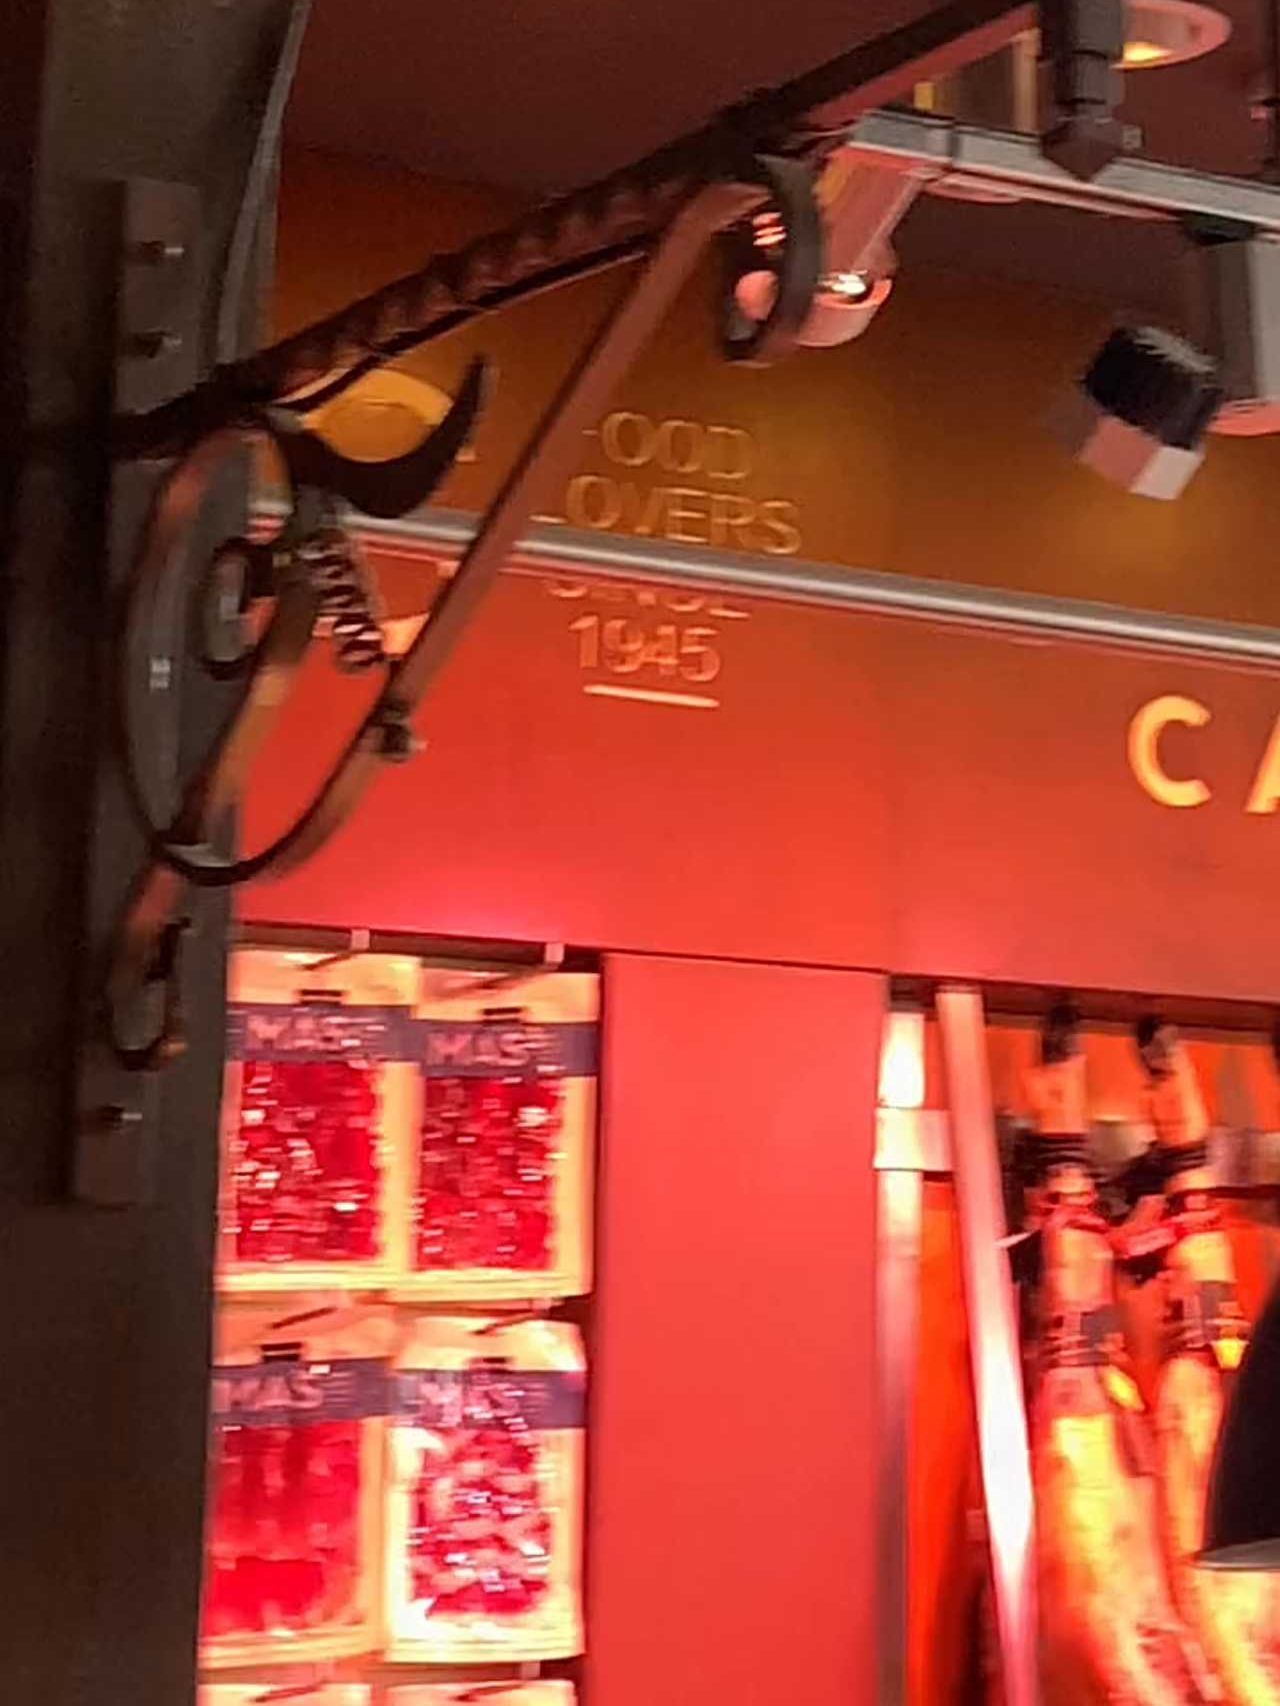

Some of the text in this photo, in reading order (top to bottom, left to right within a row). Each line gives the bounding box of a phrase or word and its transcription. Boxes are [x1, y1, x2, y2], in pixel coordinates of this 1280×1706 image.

[581, 411, 753, 480] OOD
[528, 474, 802, 555] OVERS
[568, 614, 721, 682] 1945
